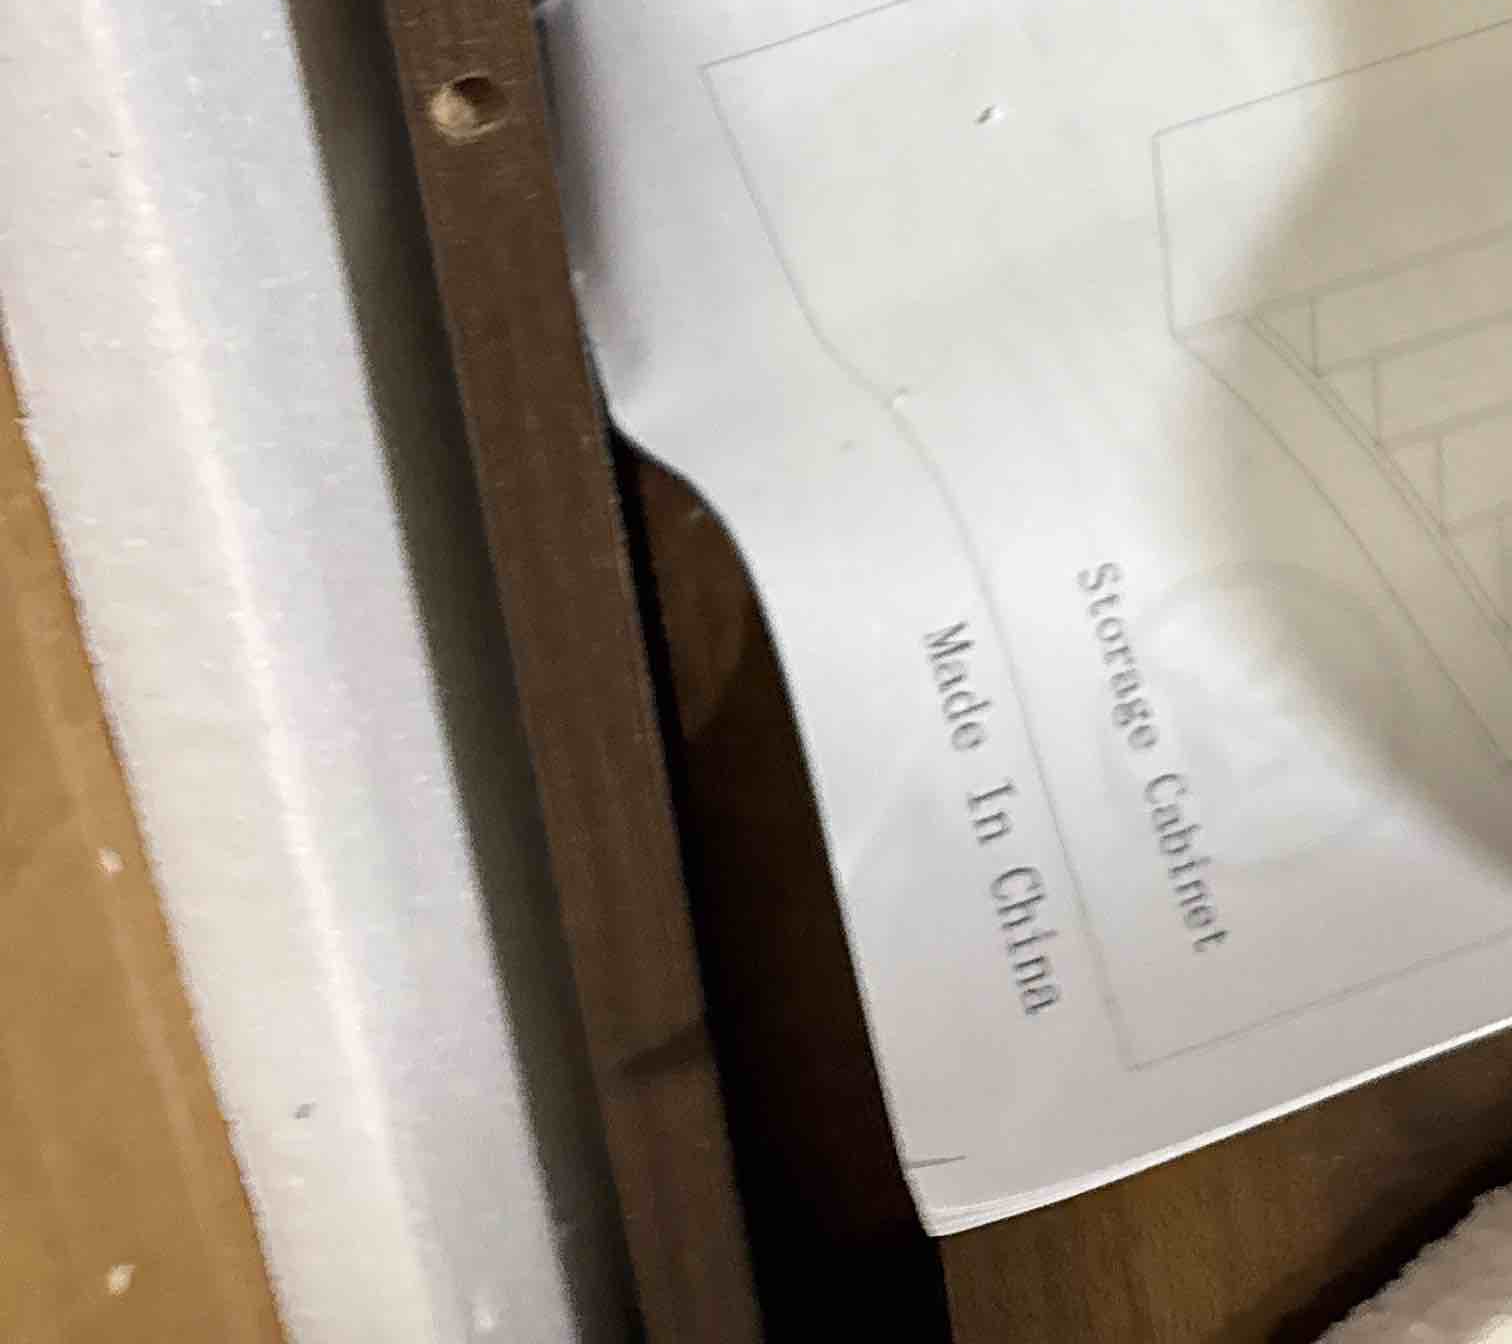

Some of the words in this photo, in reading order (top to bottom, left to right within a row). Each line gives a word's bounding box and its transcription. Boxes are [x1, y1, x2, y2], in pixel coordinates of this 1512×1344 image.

[923, 620, 993, 753] Made
[1076, 561, 1161, 751] Storage
[1144, 772, 1229, 953] Cabinet
[967, 778, 1017, 846] In
[989, 865, 1061, 1017] China
